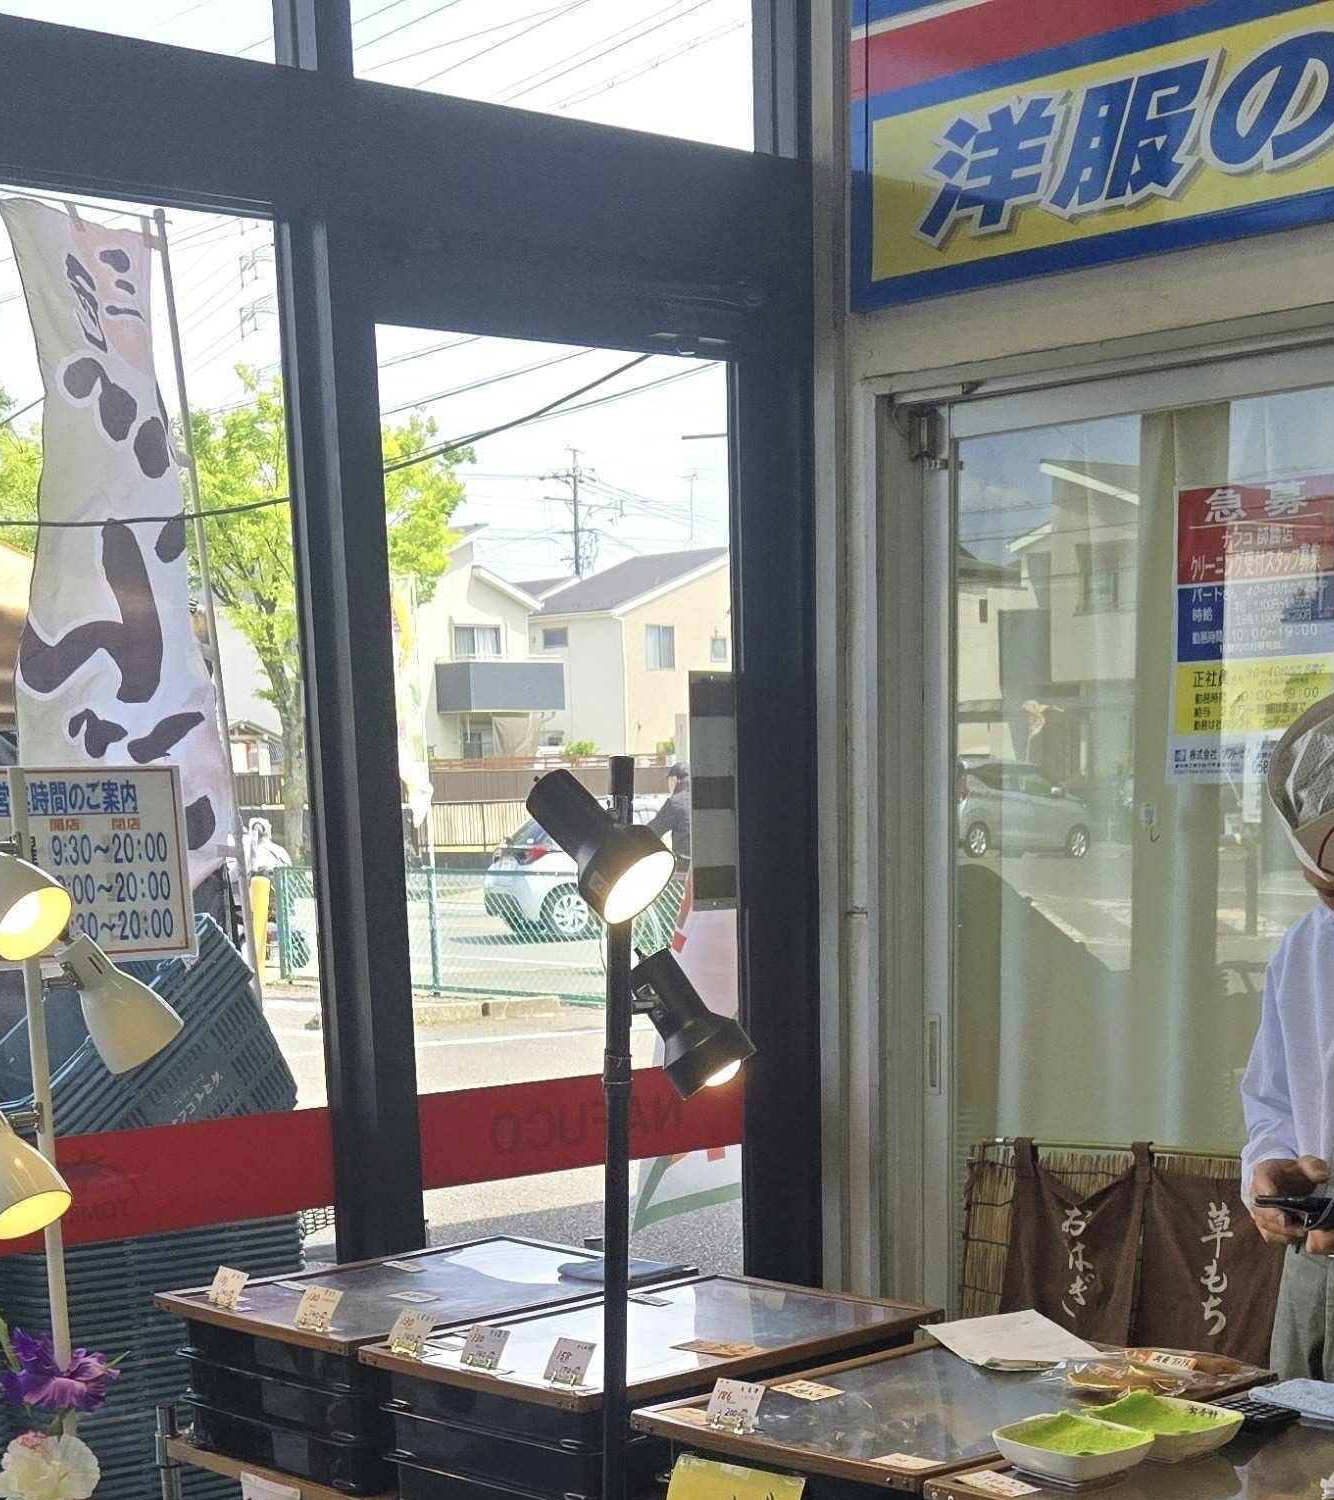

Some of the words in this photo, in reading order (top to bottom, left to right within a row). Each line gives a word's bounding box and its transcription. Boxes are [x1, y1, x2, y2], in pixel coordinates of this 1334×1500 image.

[1205, 483, 1308, 523] 急募
[1060, 1205, 1101, 1319] おはぎ
[1199, 1201, 1235, 1336] 草もち
